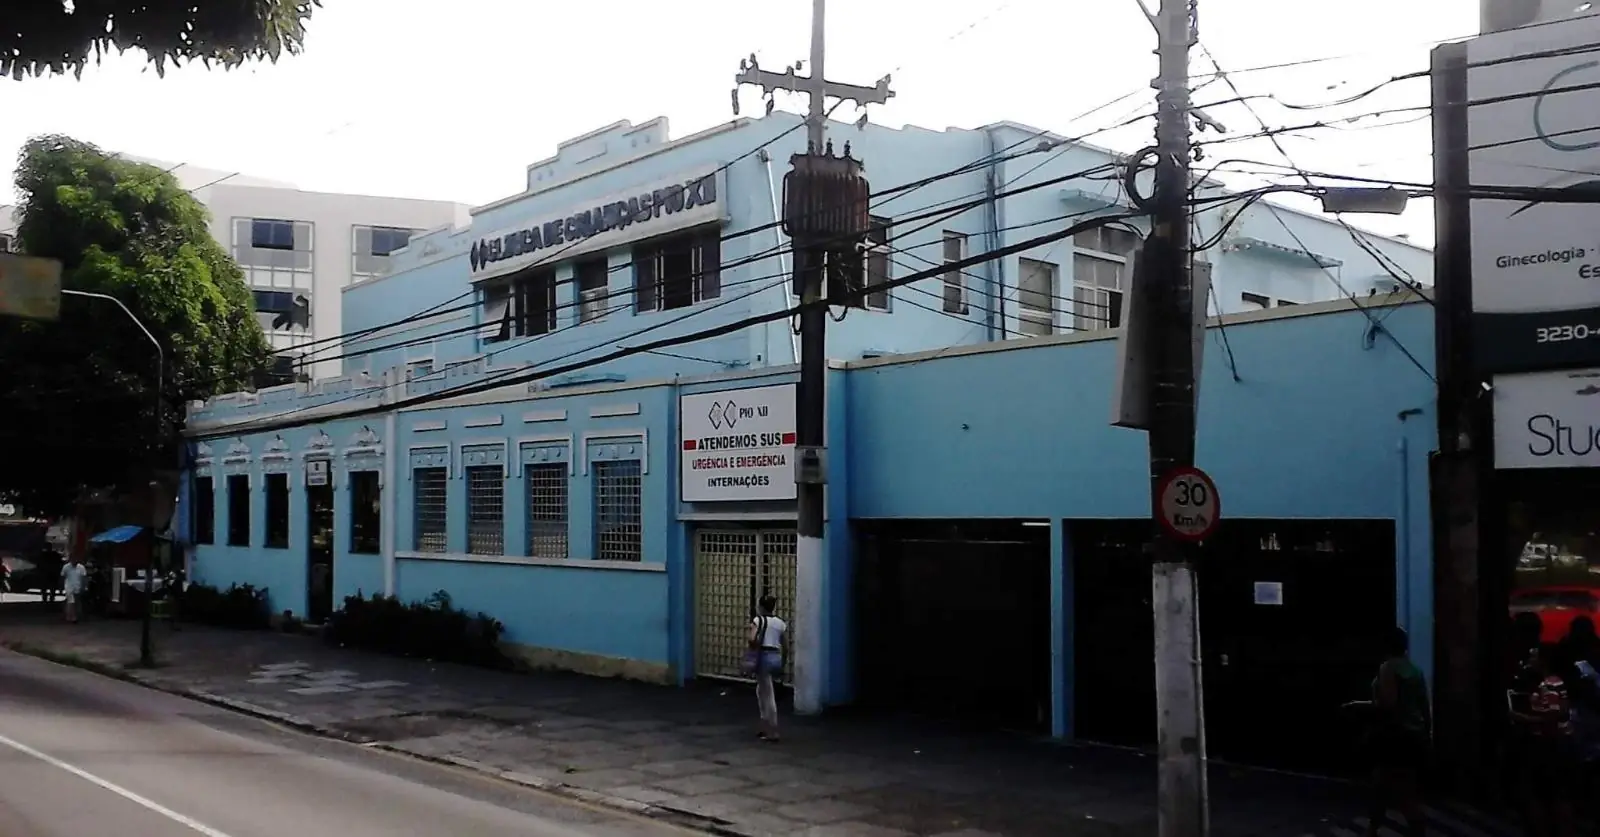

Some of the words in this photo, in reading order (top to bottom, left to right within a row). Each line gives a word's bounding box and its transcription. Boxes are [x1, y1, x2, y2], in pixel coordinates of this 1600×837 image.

[543, 219, 565, 248] DE
[652, 184, 685, 218] PIO
[685, 172, 717, 210] XII
[1496, 247, 1585, 268] Ginecologia
[739, 407, 754, 418] PIO
[698, 434, 757, 451] ATENDEMOS
[760, 432, 781, 446] SUS
[730, 457, 735, 468] E
[707, 474, 770, 488] INTERNAÇÕES
[1175, 480, 1206, 507] 30
[1173, 513, 1207, 527] Km/h
